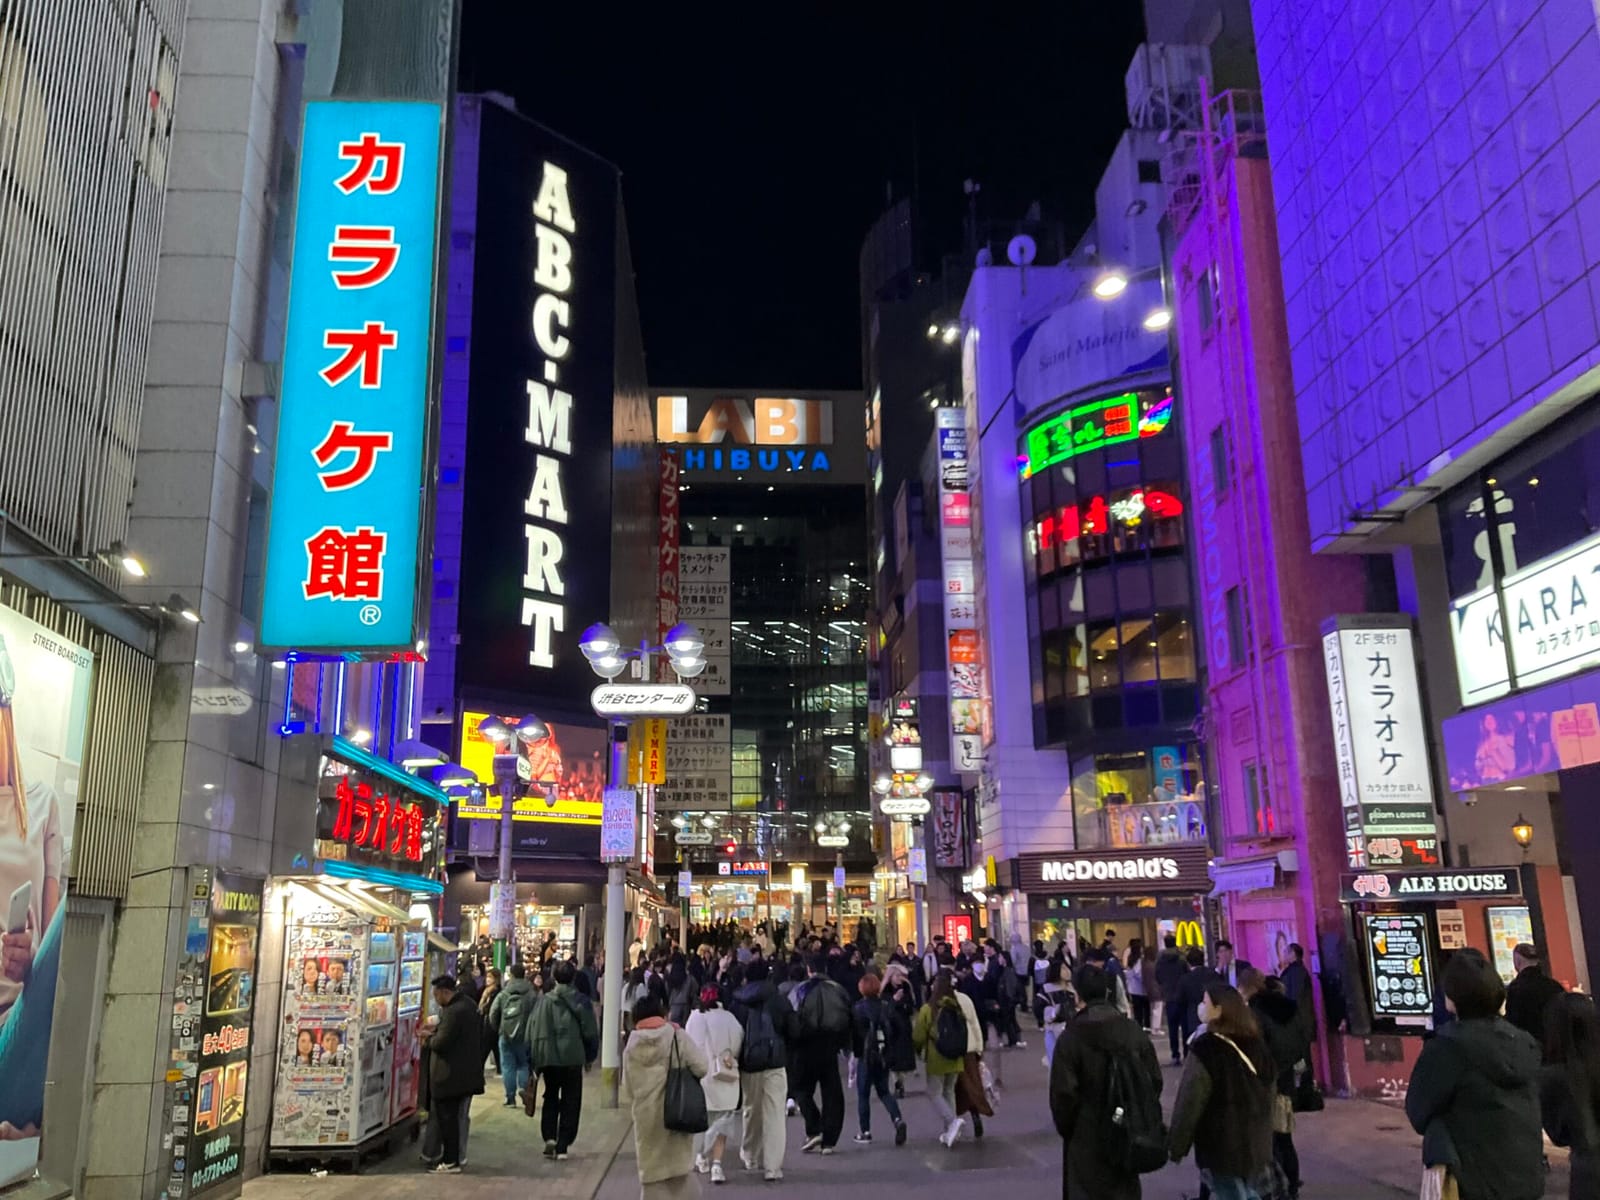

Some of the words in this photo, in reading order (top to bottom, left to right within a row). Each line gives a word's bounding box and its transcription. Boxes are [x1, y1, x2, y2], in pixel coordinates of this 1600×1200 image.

[303, 132, 405, 601] カラオケ館
[521, 160, 575, 669] ABC-MART
[656, 396, 833, 444] LABI
[667, 449, 830, 471] HIBUYA
[1486, 563, 1600, 647] KARA
[33, 632, 57, 653] STREET
[57, 645, 78, 663] BOARD
[78, 656, 89, 668] SET
[1354, 634, 1370, 645] 2F
[1373, 633, 1397, 645] 受付
[598, 693, 689, 704] 渋谷センター街
[1366, 651, 1404, 776] カラオケ
[1042, 857, 1179, 881] McDonald's
[1353, 874, 1391, 897] HUB
[1398, 875, 1436, 893] ALE
[1438, 874, 1507, 892] HOUSE
